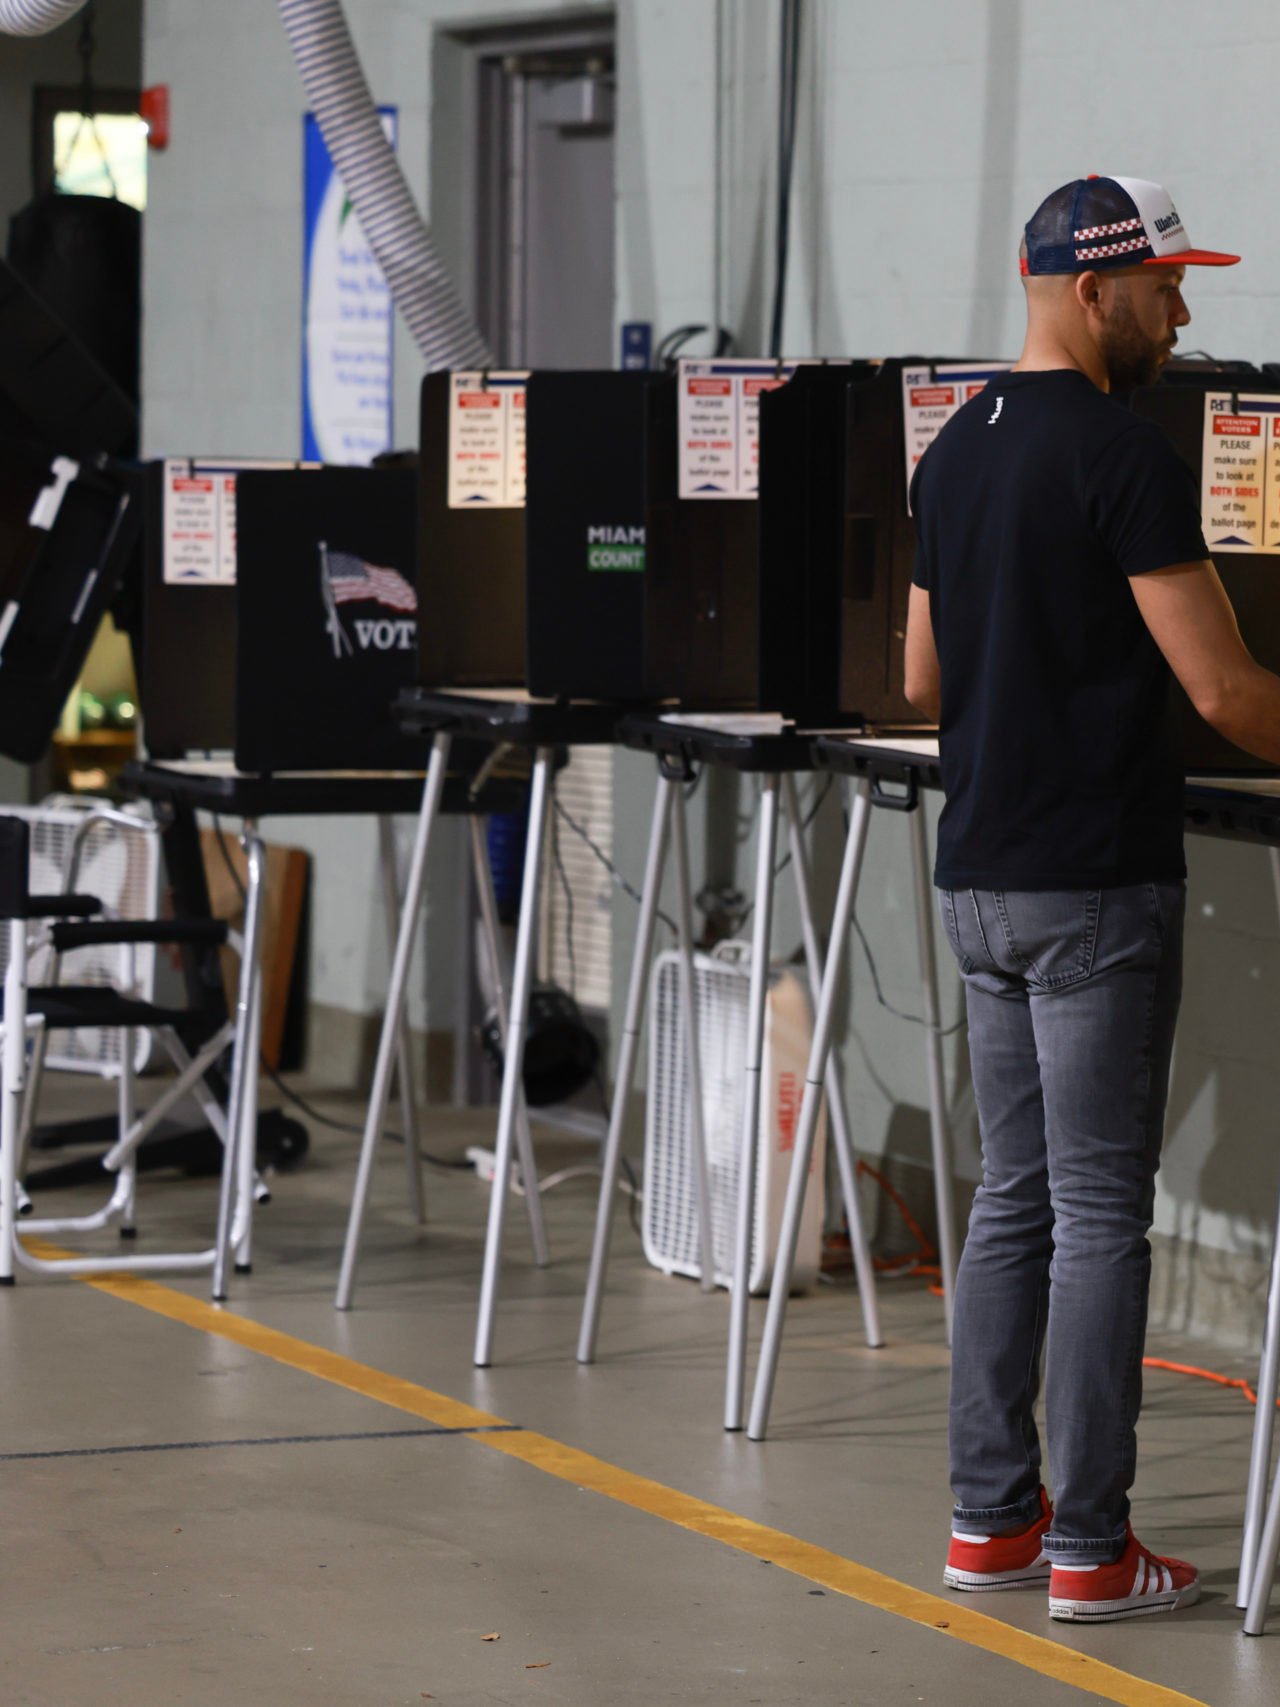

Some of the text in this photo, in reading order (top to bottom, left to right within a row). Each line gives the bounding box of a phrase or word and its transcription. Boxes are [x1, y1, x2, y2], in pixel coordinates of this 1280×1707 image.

[1221, 440, 1251, 449] PLEASE
[1217, 472, 1254, 481] to look at
[1210, 487, 1258, 497] BOTH SIDES
[1223, 503, 1245, 511] of the
[1211, 518, 1256, 529] ballot page
[1271, 520, 1279, 528] de
[354, 620, 417, 650] VOT
